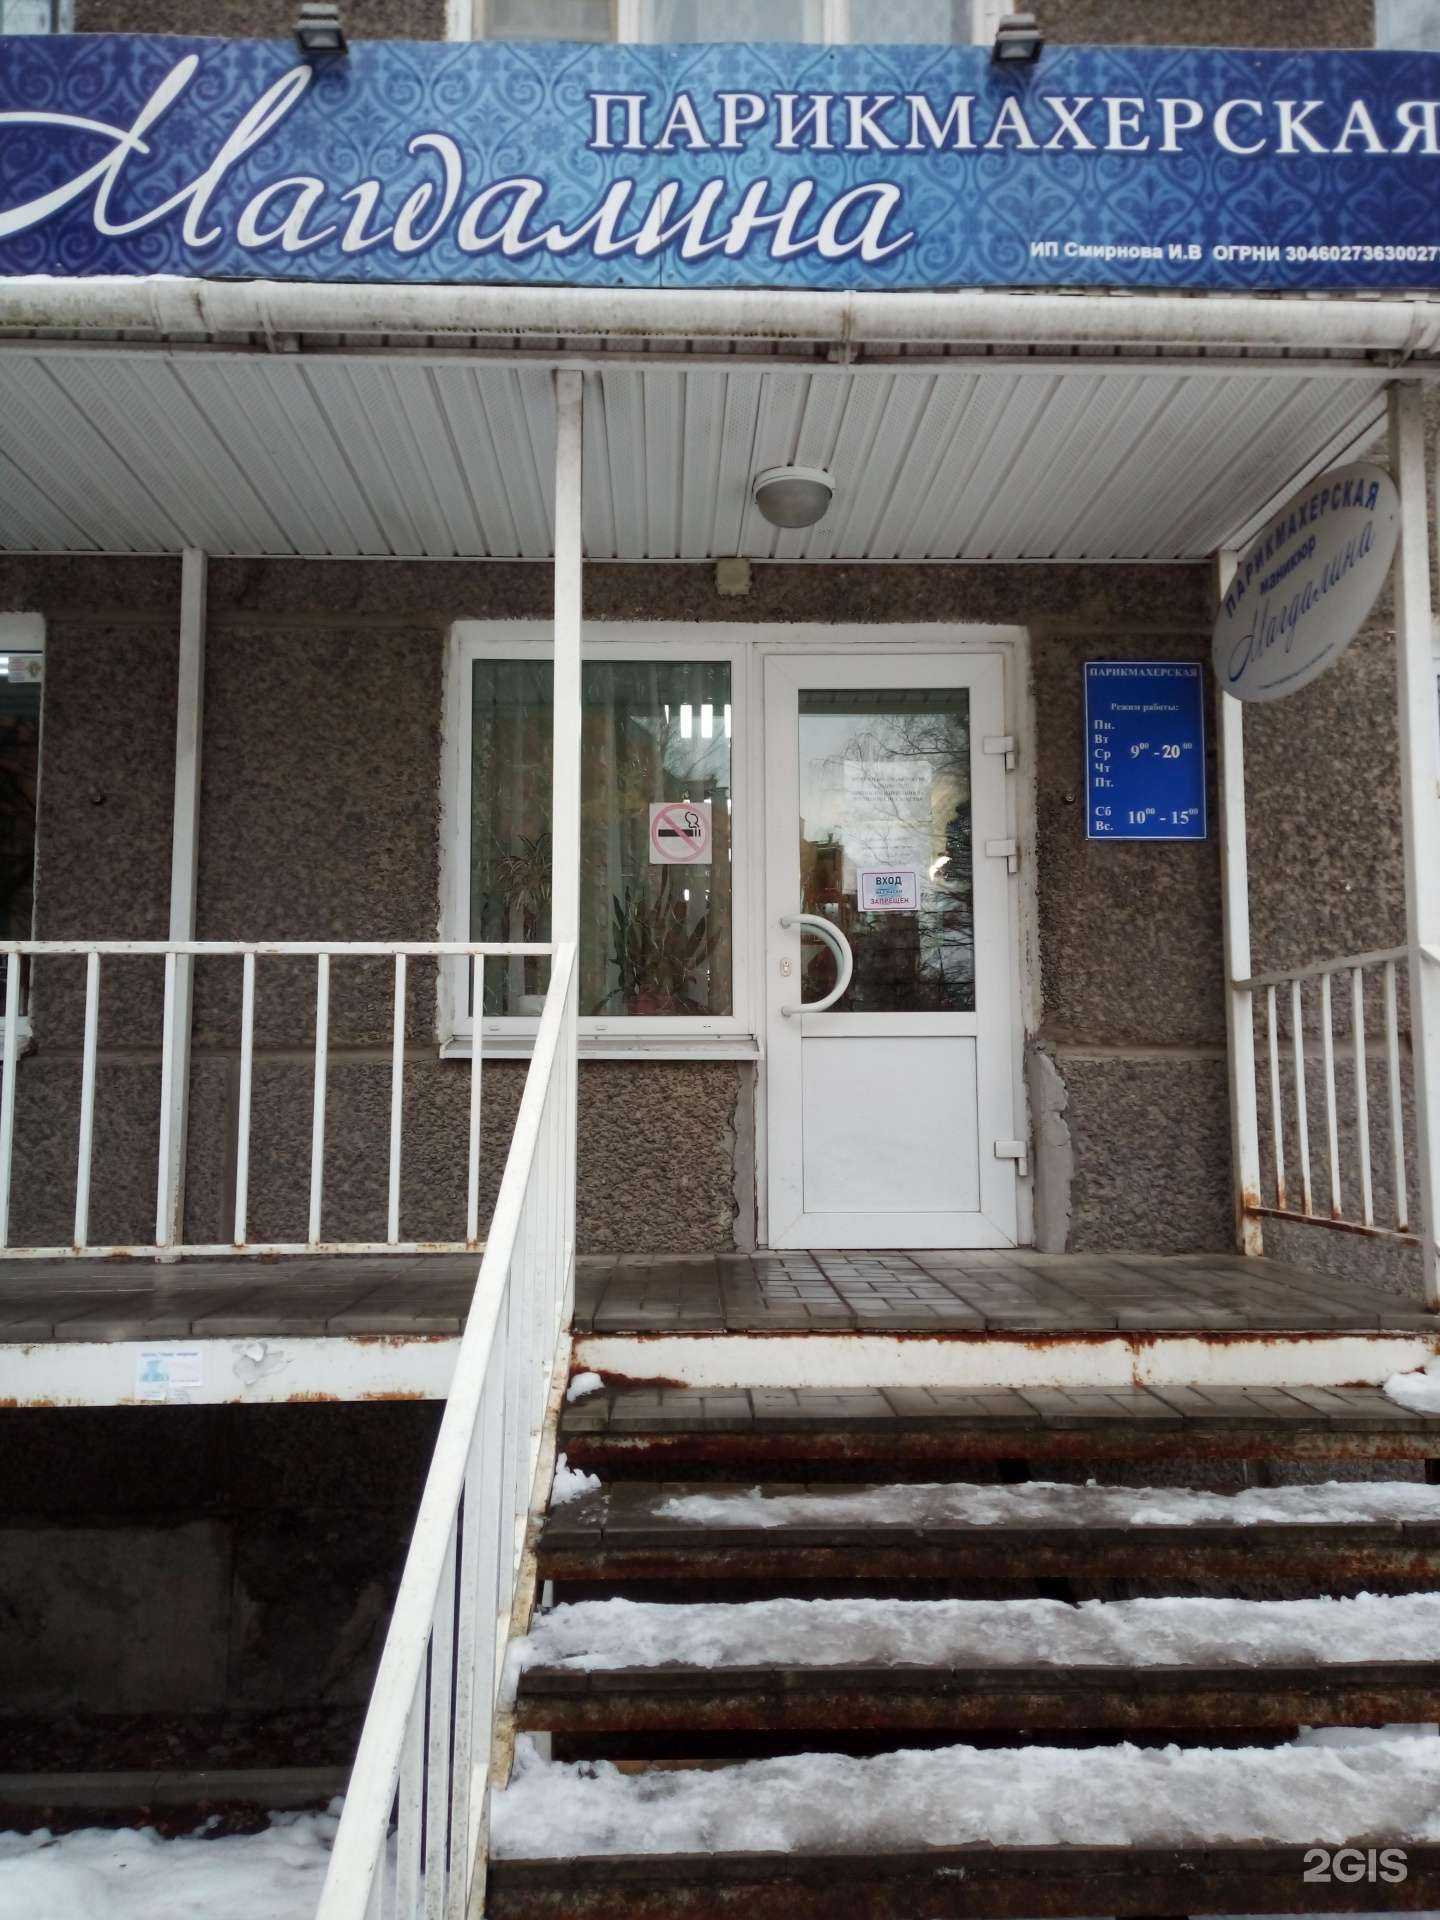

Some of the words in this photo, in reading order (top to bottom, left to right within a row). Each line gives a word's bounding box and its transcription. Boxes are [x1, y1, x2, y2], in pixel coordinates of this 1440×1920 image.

[589, 94, 1440, 154] ПАРИКМАХЕРСКАЯ
[0, 54, 914, 262] Магдалина
[1030, 241, 1058, 257] ИП
[1064, 242, 1163, 261] Смирнова
[1213, 245, 1280, 261] ОГРНИ
[1285, 245, 1440, 261] 30460273630027
[1225, 478, 1380, 618] ПАРИКМАХЕРСКАЯ
[1089, 667, 1198, 677] ПАРИКМАХЕРСКАЯ
[1111, 703, 1141, 711] Режим
[1095, 734, 1109, 744] Вт
[1095, 749, 1111, 760] Ср
[1095, 763, 1111, 773] Чт
[1095, 807, 1112, 817] Сб
[875, 876, 902, 886] ВХОД
